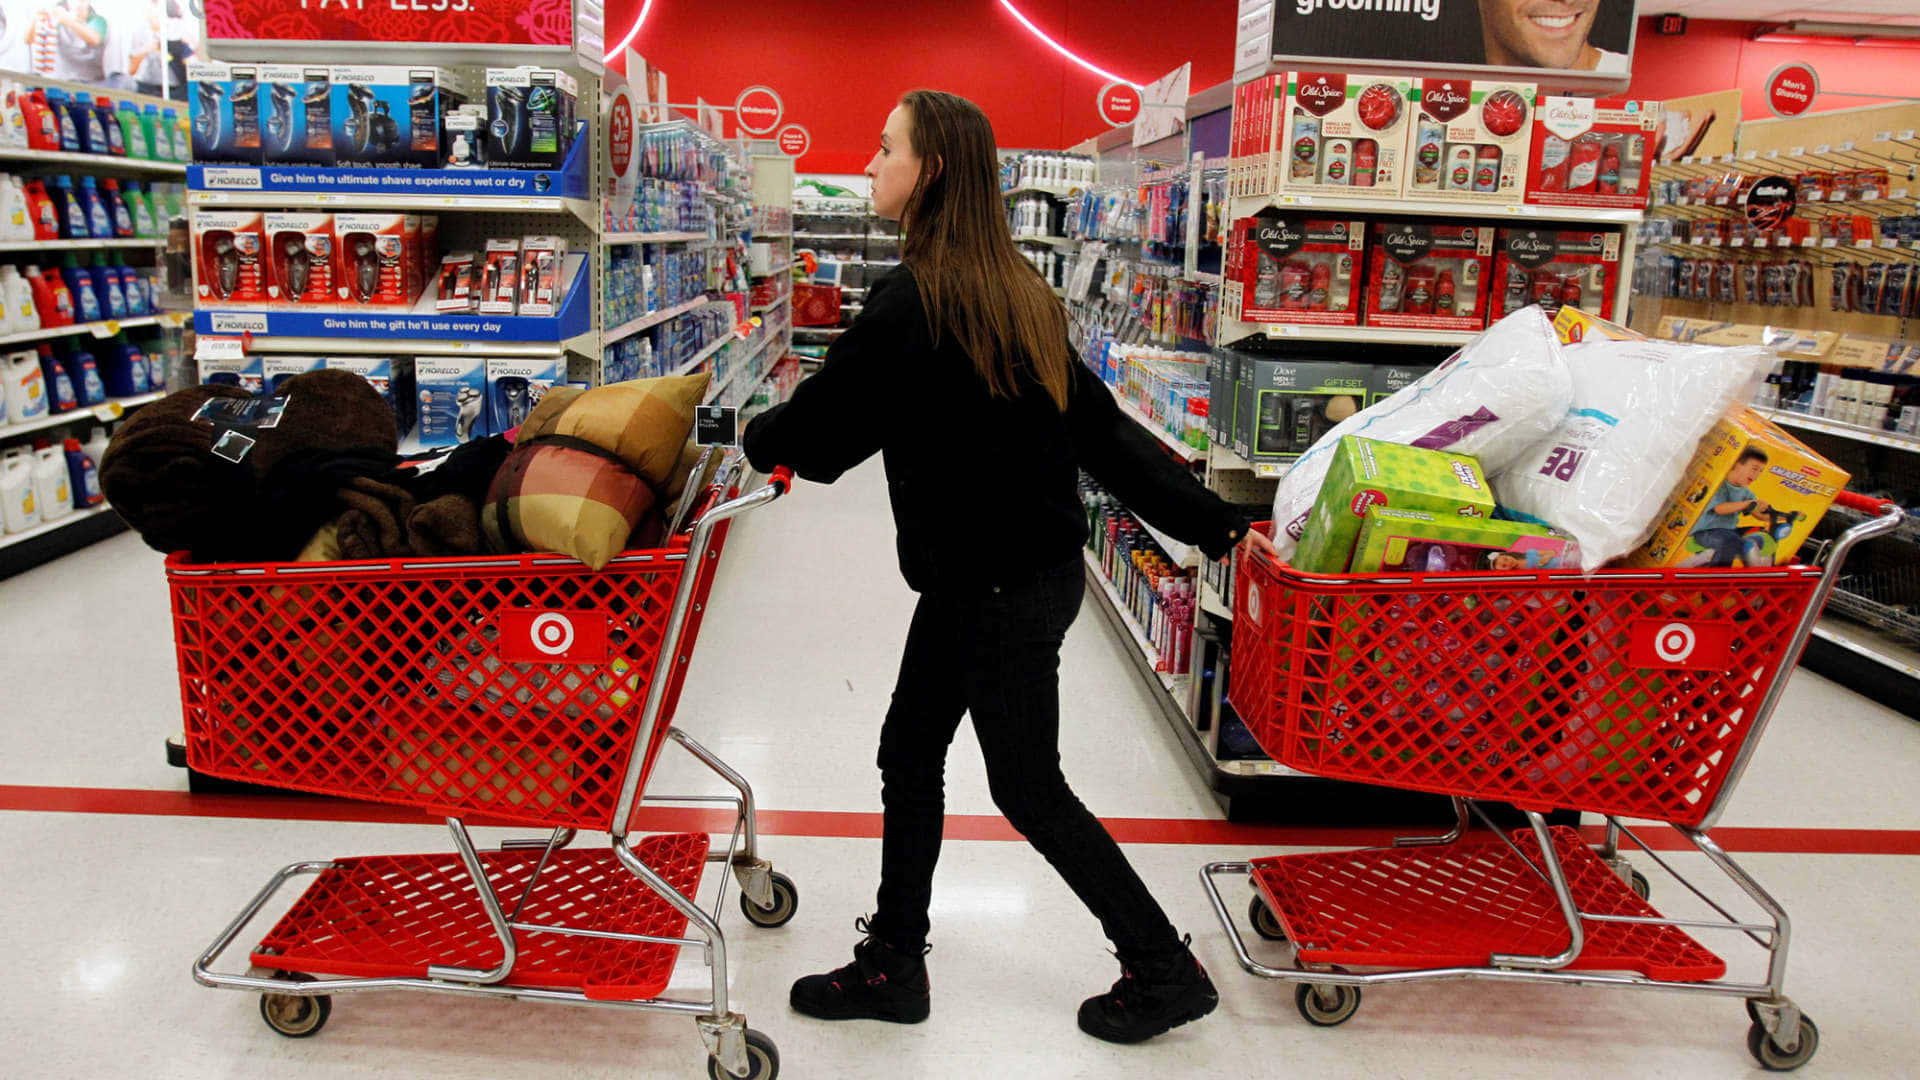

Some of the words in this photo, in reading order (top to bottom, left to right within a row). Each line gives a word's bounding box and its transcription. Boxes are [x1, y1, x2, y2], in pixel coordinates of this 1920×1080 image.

[1664, 16, 1683, 32] EXIT
[1301, 84, 1320, 97] Old
[1320, 84, 1343, 97] Spice
[1782, 79, 1806, 90] Men's
[1426, 90, 1443, 103] Old
[1443, 91, 1468, 104] Spice
[1776, 88, 1808, 102] Shaving
[742, 106, 777, 116] Whitening
[216, 177, 258, 186] NORELCO
[270, 173, 293, 183] Give
[296, 173, 317, 184] him
[318, 174, 335, 184] the
[337, 174, 379, 185] ultimate
[381, 175, 412, 185] shave
[414, 177, 472, 187] experience
[474, 177, 493, 186] wet
[508, 178, 526, 189] dry
[1260, 227, 1278, 240] Old
[1278, 229, 1301, 241] Spice
[1387, 233, 1404, 245] Old
[1405, 234, 1429, 246] Spice
[1511, 239, 1529, 251] Old
[1529, 240, 1552, 252] Spice
[224, 322, 264, 330] NORELCO
[324, 318, 346, 328] Give
[348, 319, 368, 329] him
[370, 319, 386, 329] the
[389, 320, 406, 331] gift
[408, 320, 429, 330] he'll
[432, 322, 450, 331] use
[452, 323, 480, 332] every
[482, 322, 501, 333] day
[497, 368, 532, 376] NORELCO
[1273, 367, 1296, 376] Dove
[1387, 368, 1411, 379] Dove
[1324, 378, 1346, 387] GIFT
[1347, 379, 1363, 387] SET
[1539, 447, 1584, 482] RE
